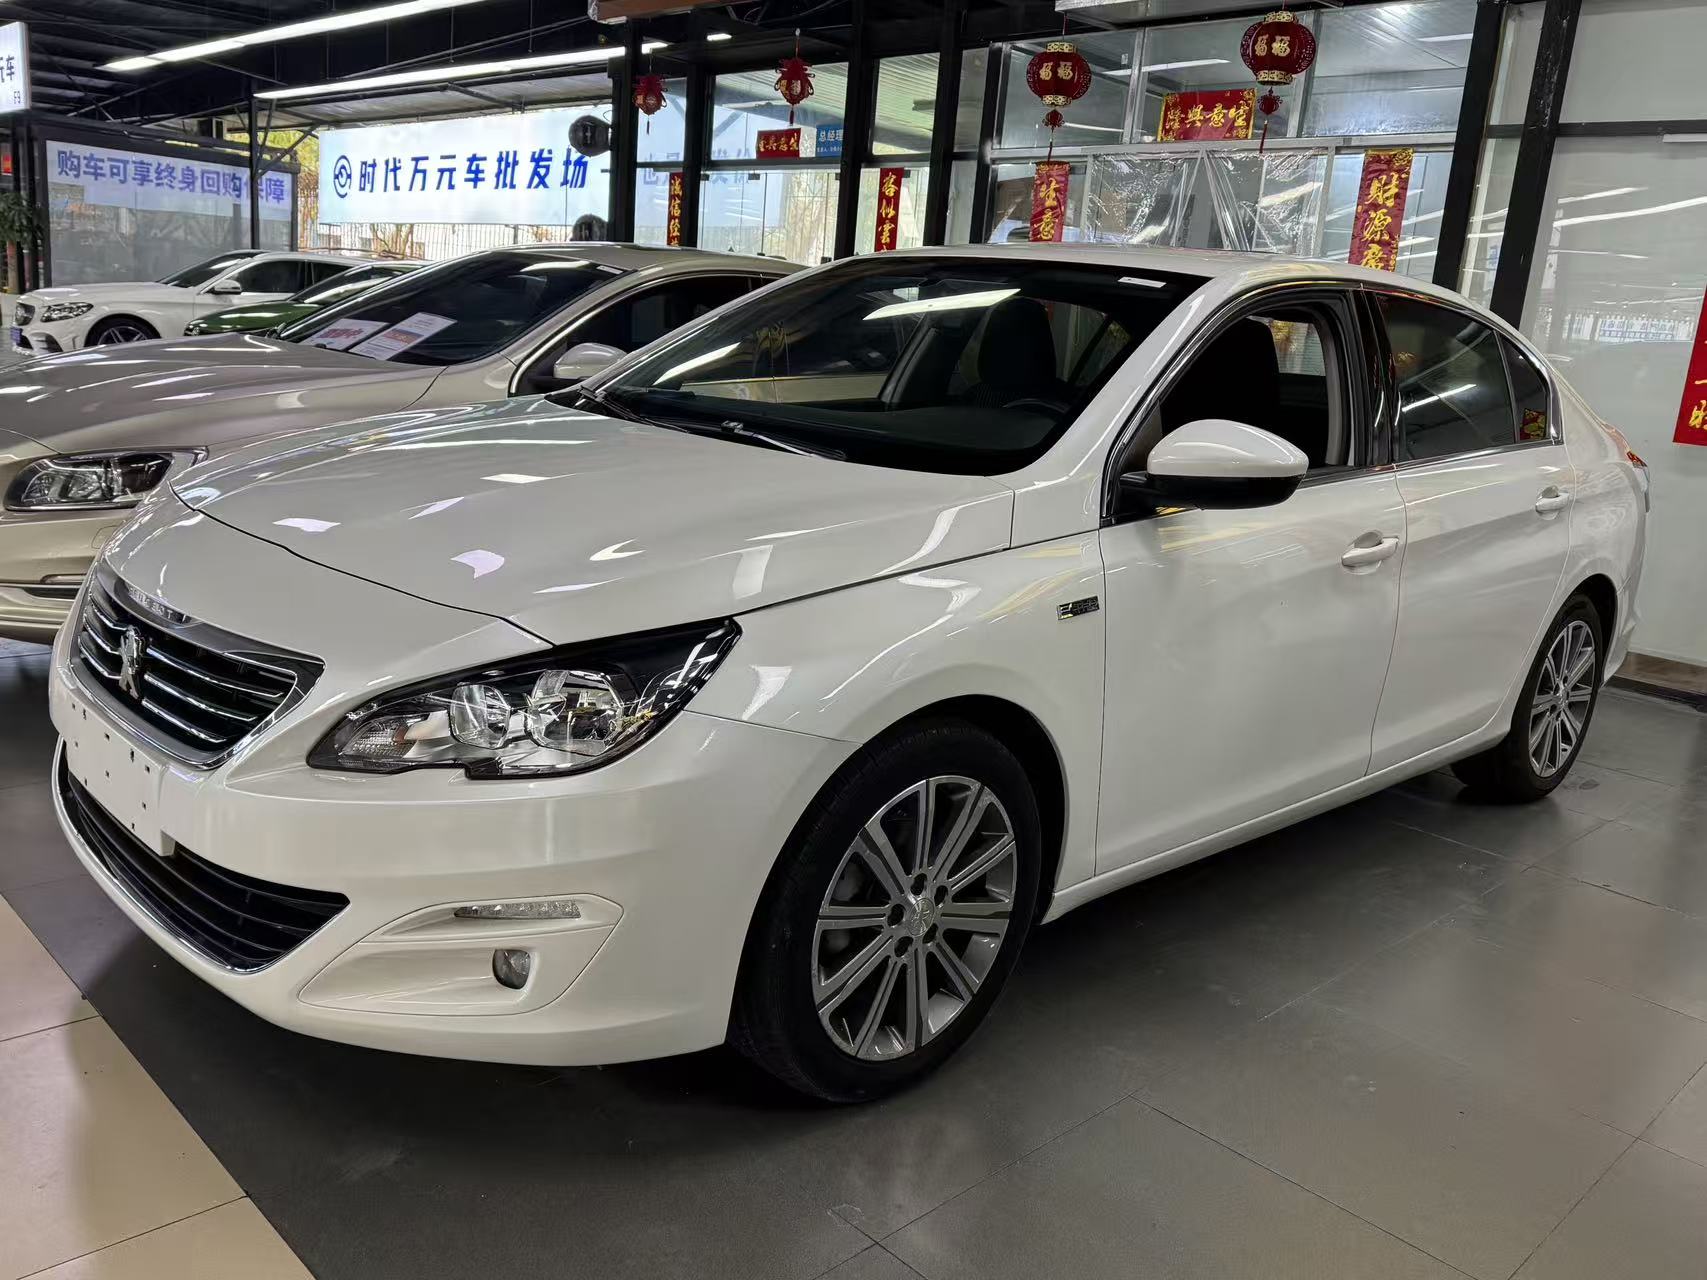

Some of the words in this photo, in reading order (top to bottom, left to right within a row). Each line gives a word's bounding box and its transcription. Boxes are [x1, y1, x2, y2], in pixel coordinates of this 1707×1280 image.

[359, 145, 588, 193] 时代万元车批发场
